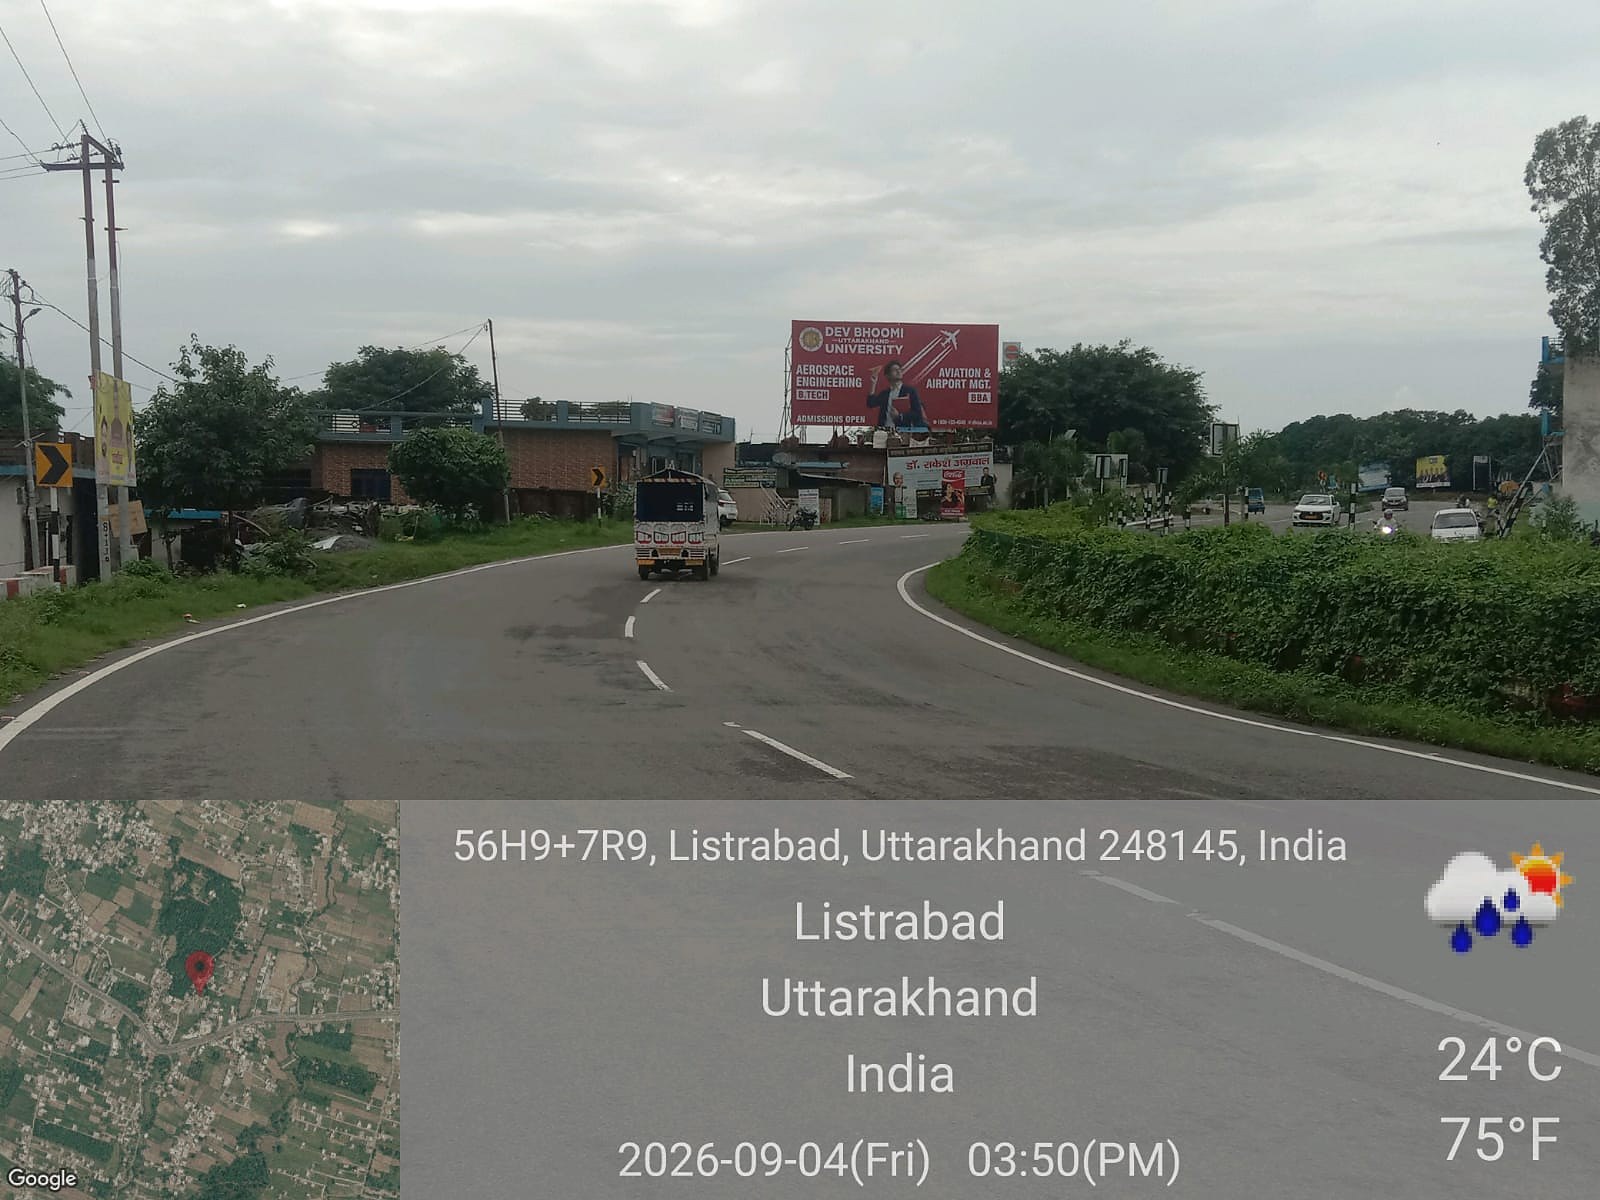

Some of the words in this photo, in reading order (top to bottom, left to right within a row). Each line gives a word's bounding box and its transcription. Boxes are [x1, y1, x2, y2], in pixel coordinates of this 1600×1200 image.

[825, 326, 851, 337] DEV
[854, 327, 904, 338] BHOOMI
[825, 343, 904, 355] UNIVERSITY
[796, 364, 855, 376] AEROSPACE
[938, 367, 981, 378] AVIATION
[984, 367, 992, 378] &
[796, 376, 862, 388] ENGINEERING
[926, 379, 968, 389] AIRPORT
[969, 379, 992, 390] MGT.
[797, 415, 844, 423] ADMISSIONS
[845, 415, 866, 423] OPEN
[905, 460, 920, 470] डॉ.
